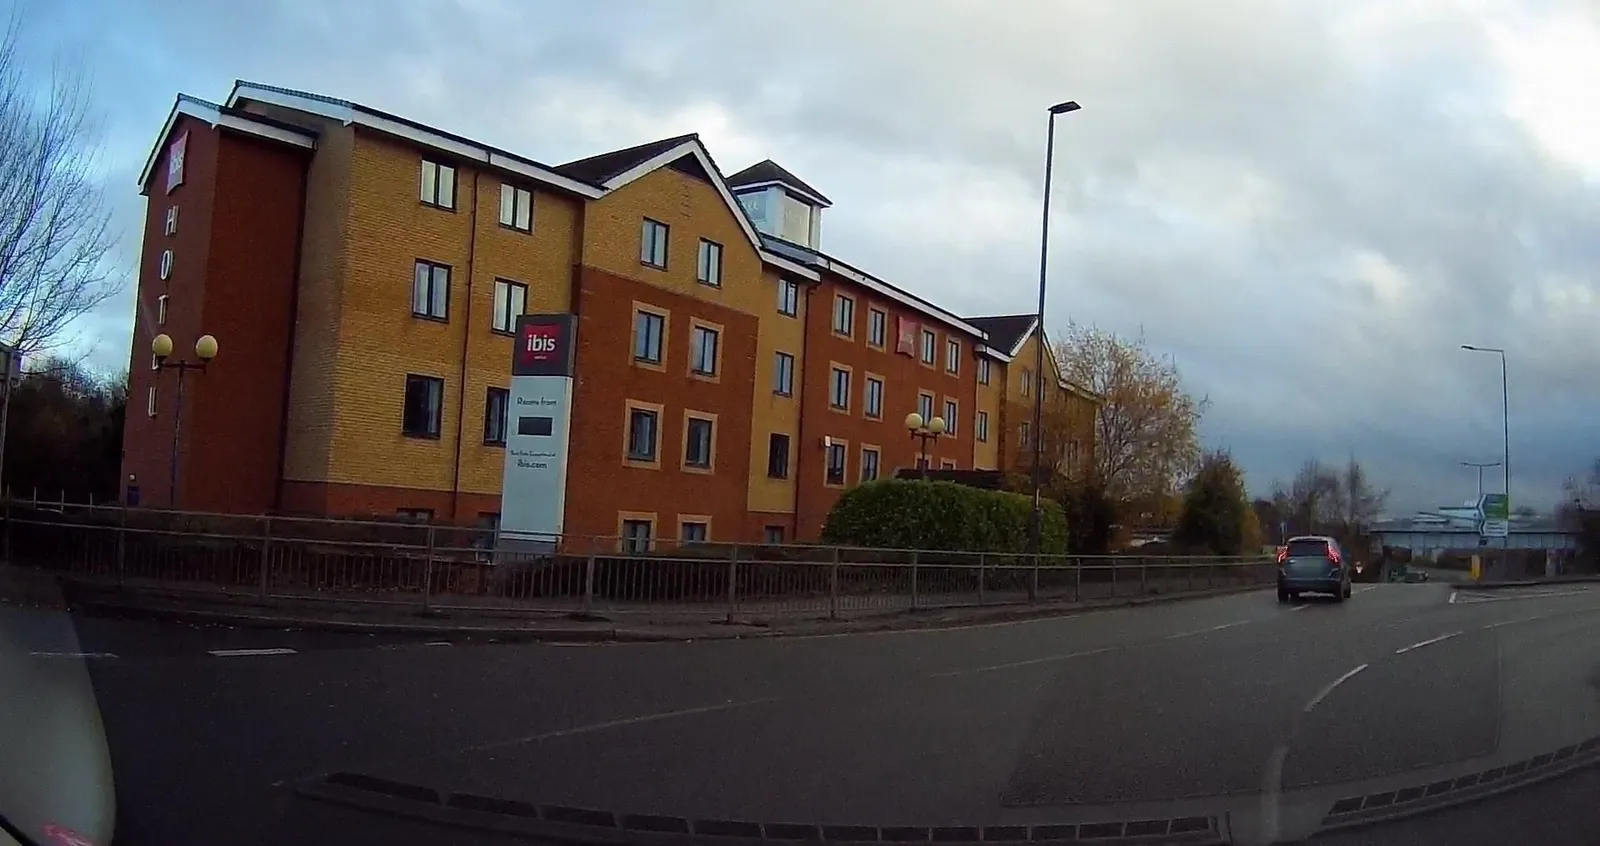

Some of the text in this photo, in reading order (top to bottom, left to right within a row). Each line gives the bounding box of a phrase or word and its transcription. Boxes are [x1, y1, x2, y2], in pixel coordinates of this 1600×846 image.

[527, 334, 556, 352] ibis
[517, 397, 557, 406] Rooms from
[517, 459, 548, 469] ibis.com
